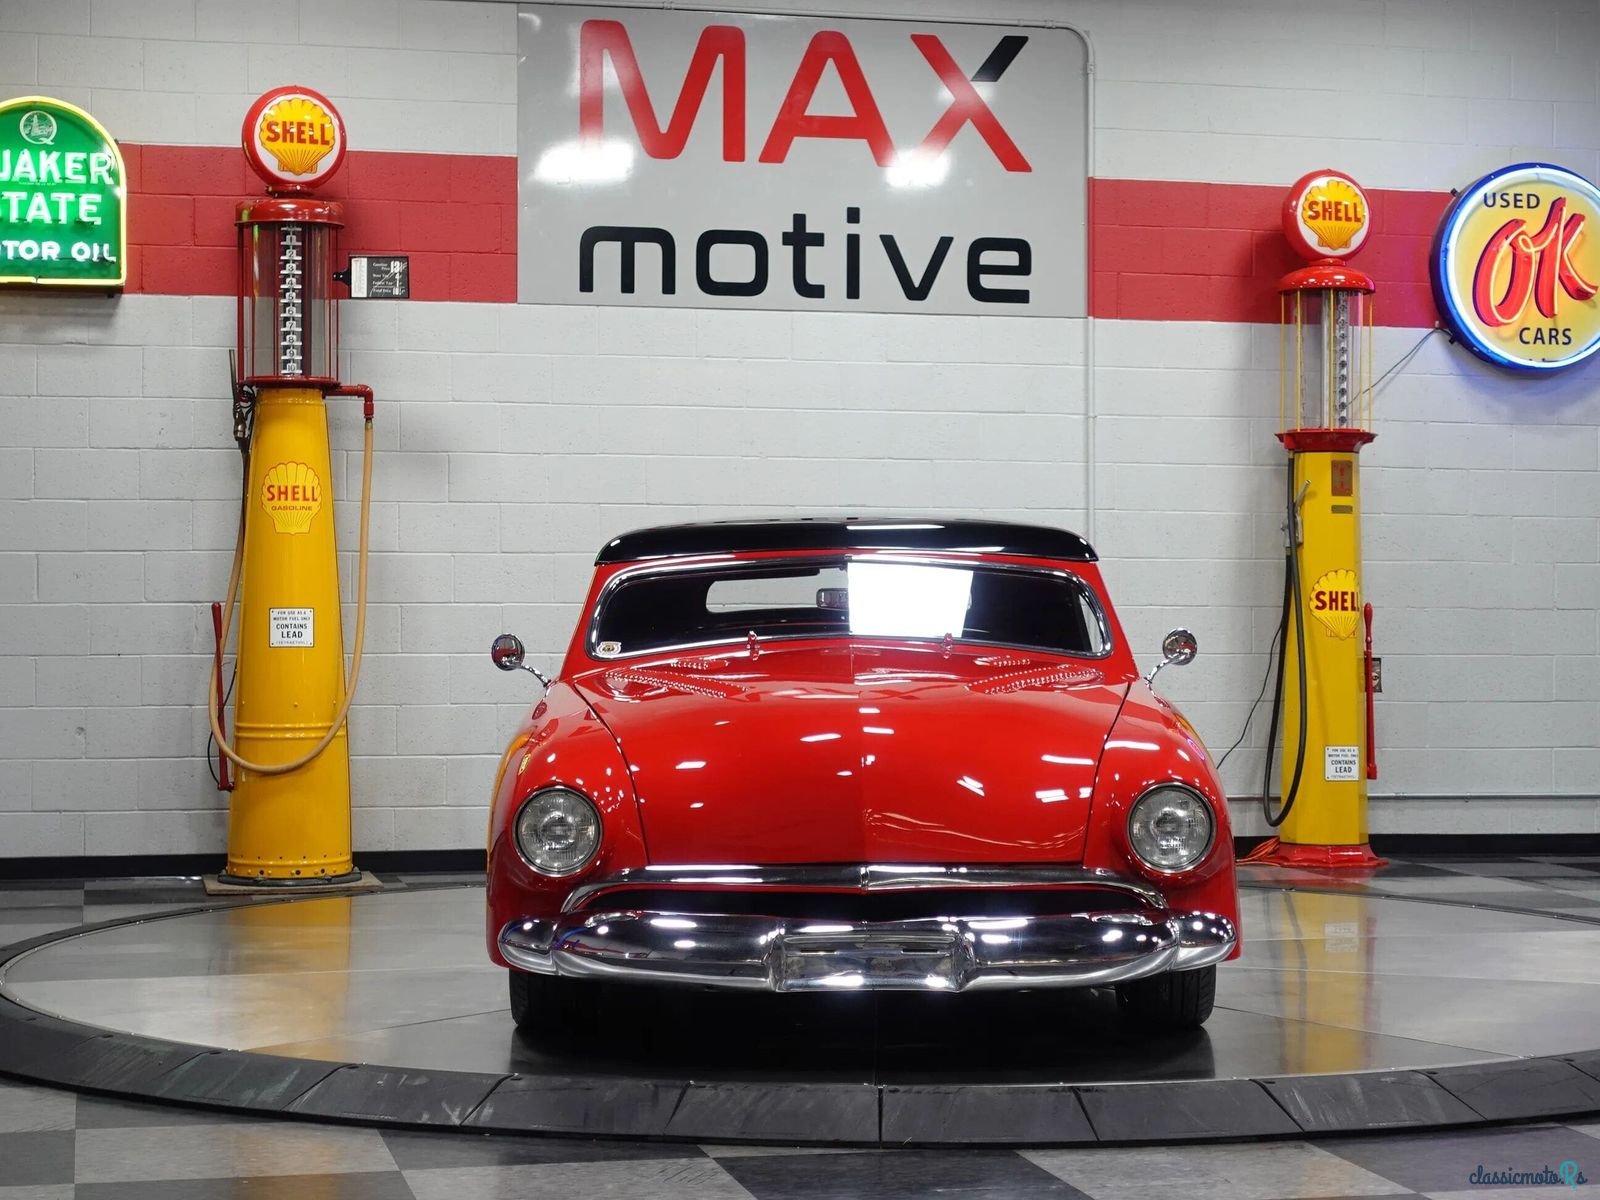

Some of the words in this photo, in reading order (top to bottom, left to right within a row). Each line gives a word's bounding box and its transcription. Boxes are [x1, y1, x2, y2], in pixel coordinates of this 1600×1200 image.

[579, 19, 1033, 174] MAX
[265, 120, 331, 147] SHELL
[0, 191, 102, 225] TATE
[1307, 200, 1362, 223] SHELL
[1483, 192, 1541, 209] USED
[0, 239, 62, 262] TOR
[71, 240, 117, 263] OIL
[578, 206, 1033, 305] motive
[1472, 196, 1599, 328] OK
[1519, 327, 1573, 345] CARS
[287, 364, 296, 372] 10
[266, 484, 319, 503] SHELL
[281, 630, 303, 639] LEAD
[1335, 766, 1353, 774] LEAD
